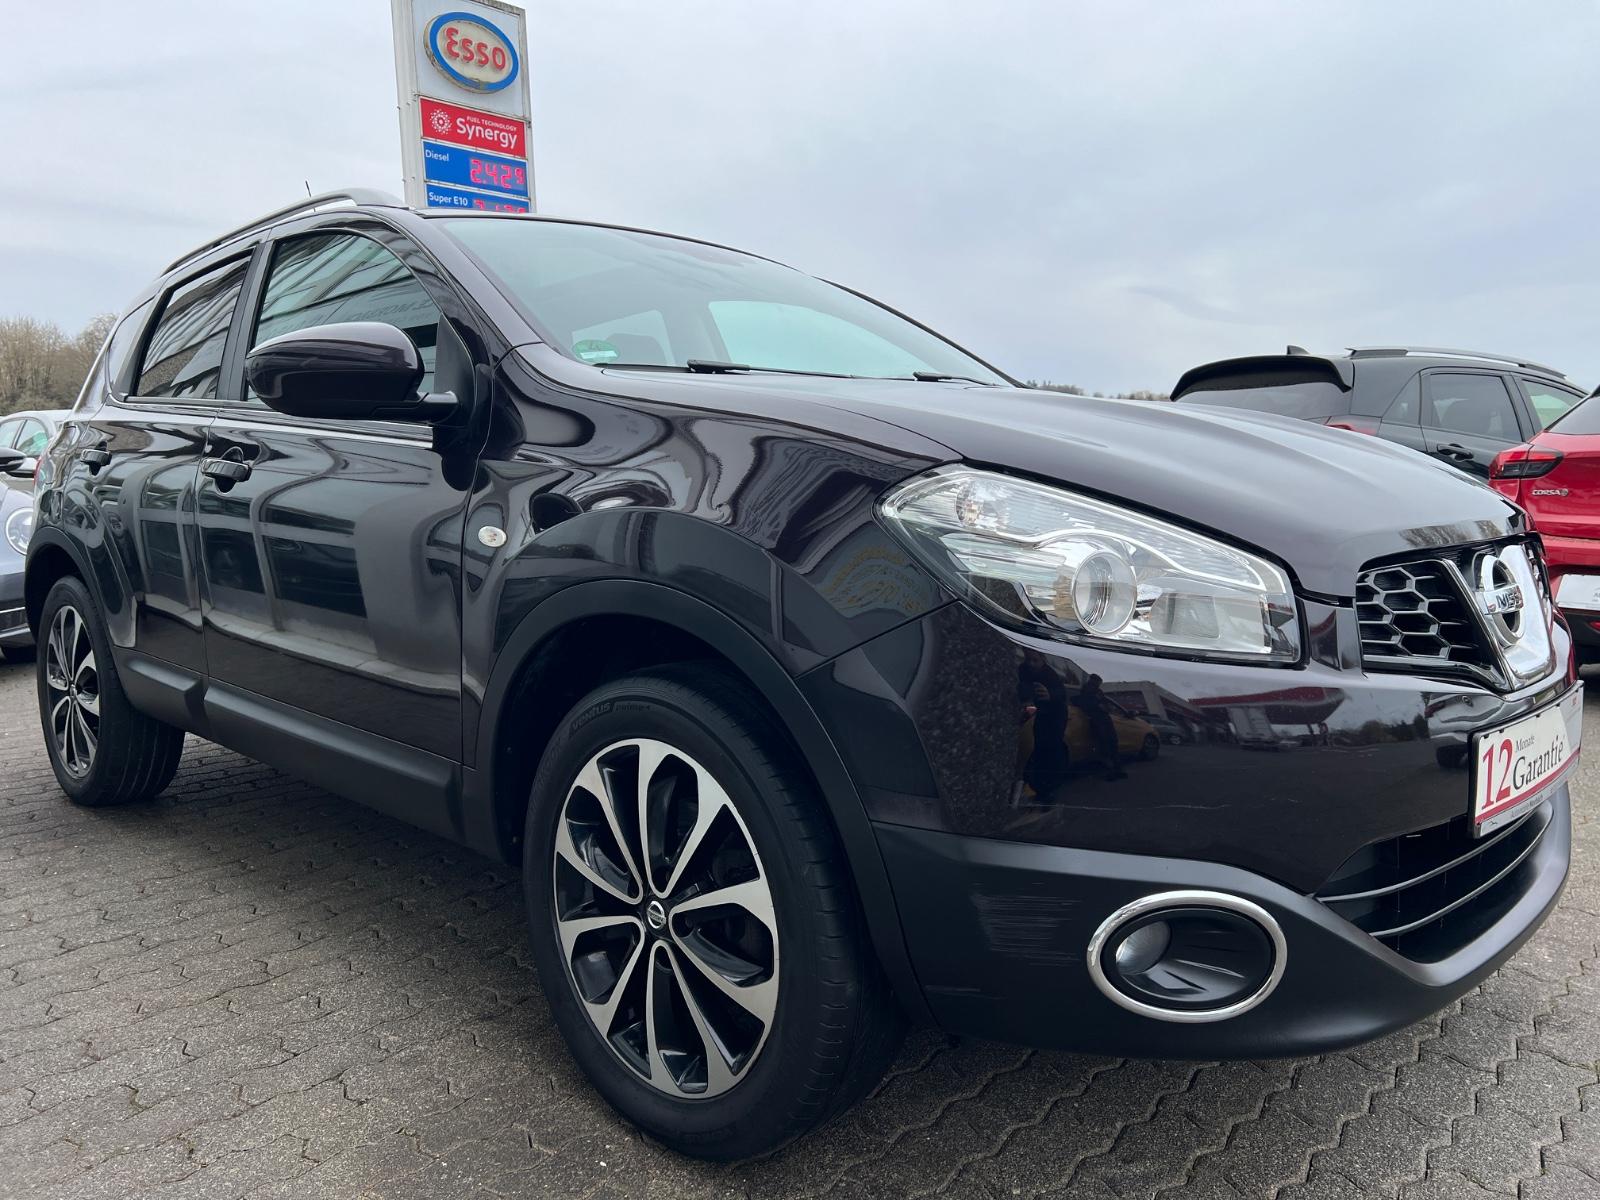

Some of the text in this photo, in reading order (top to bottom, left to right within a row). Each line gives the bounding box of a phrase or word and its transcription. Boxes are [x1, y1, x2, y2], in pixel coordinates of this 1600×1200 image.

[456, 117, 517, 149] Synergy
[425, 149, 449, 162] Diesel
[429, 192, 451, 206] Super
[453, 195, 468, 207] E10
[1496, 590, 1521, 609] NISS
[1482, 738, 1513, 810] 12
[1513, 736, 1564, 790] Garantie
